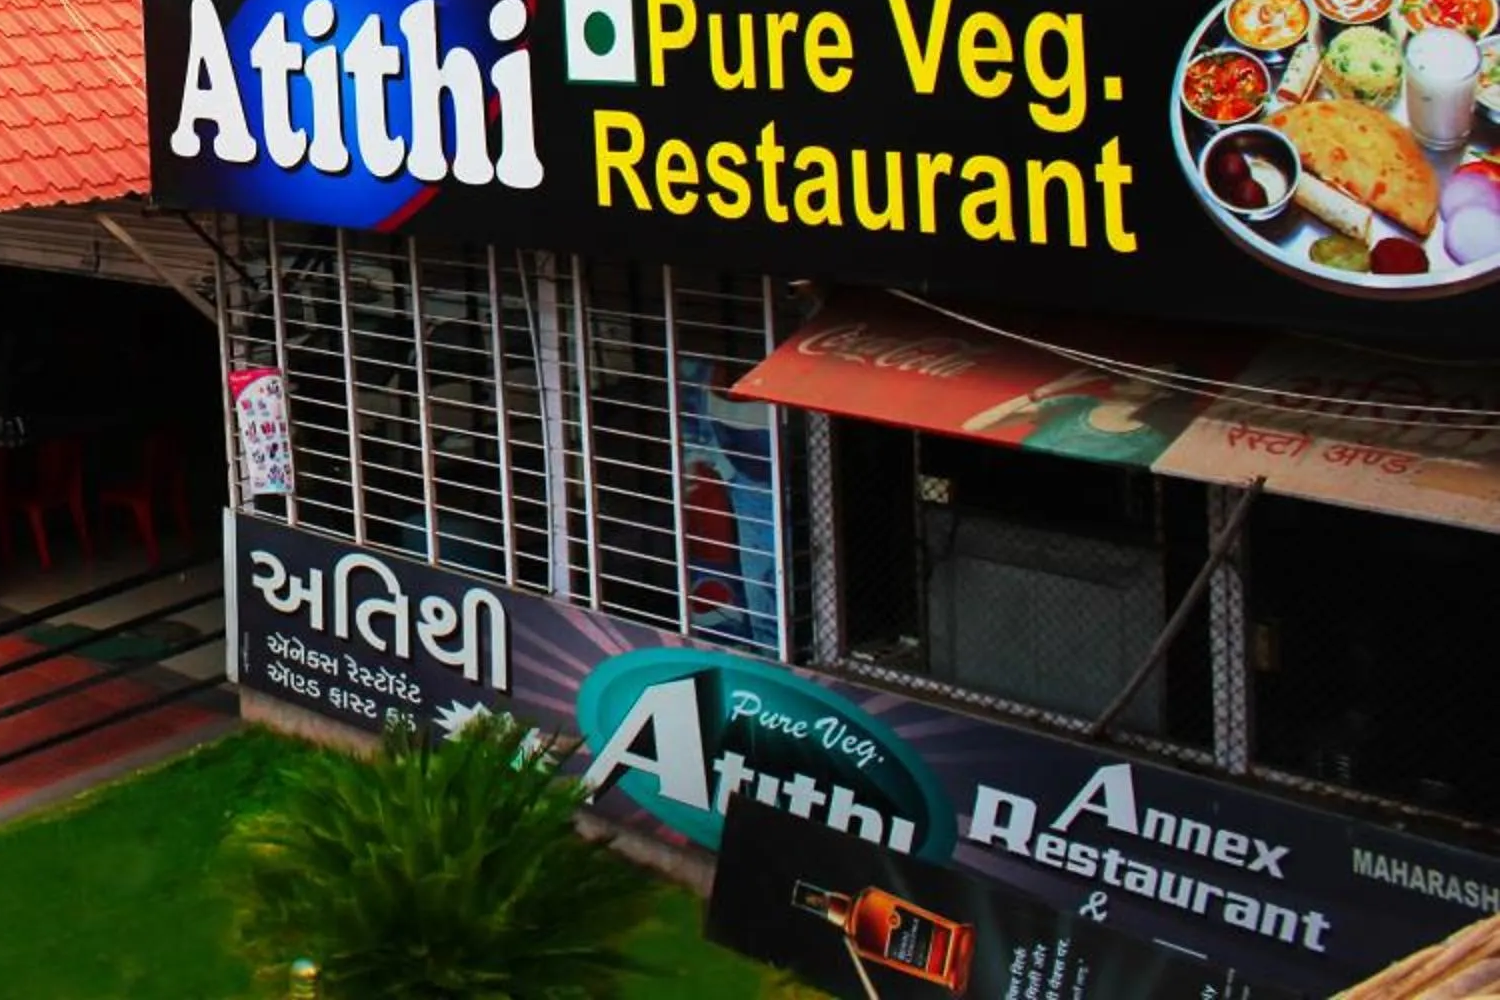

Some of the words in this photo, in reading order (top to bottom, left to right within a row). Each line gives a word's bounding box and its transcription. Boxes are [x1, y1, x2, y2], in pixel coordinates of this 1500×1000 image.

[593, 109, 1138, 254] Restaurant
[250, 550, 508, 692] અતિથી
[730, 689, 809, 740] Pure
[813, 716, 886, 768] Veg.
[968, 784, 1332, 953] Restaurant
[1049, 763, 1292, 879] Annex
[1078, 891, 1109, 922] &
